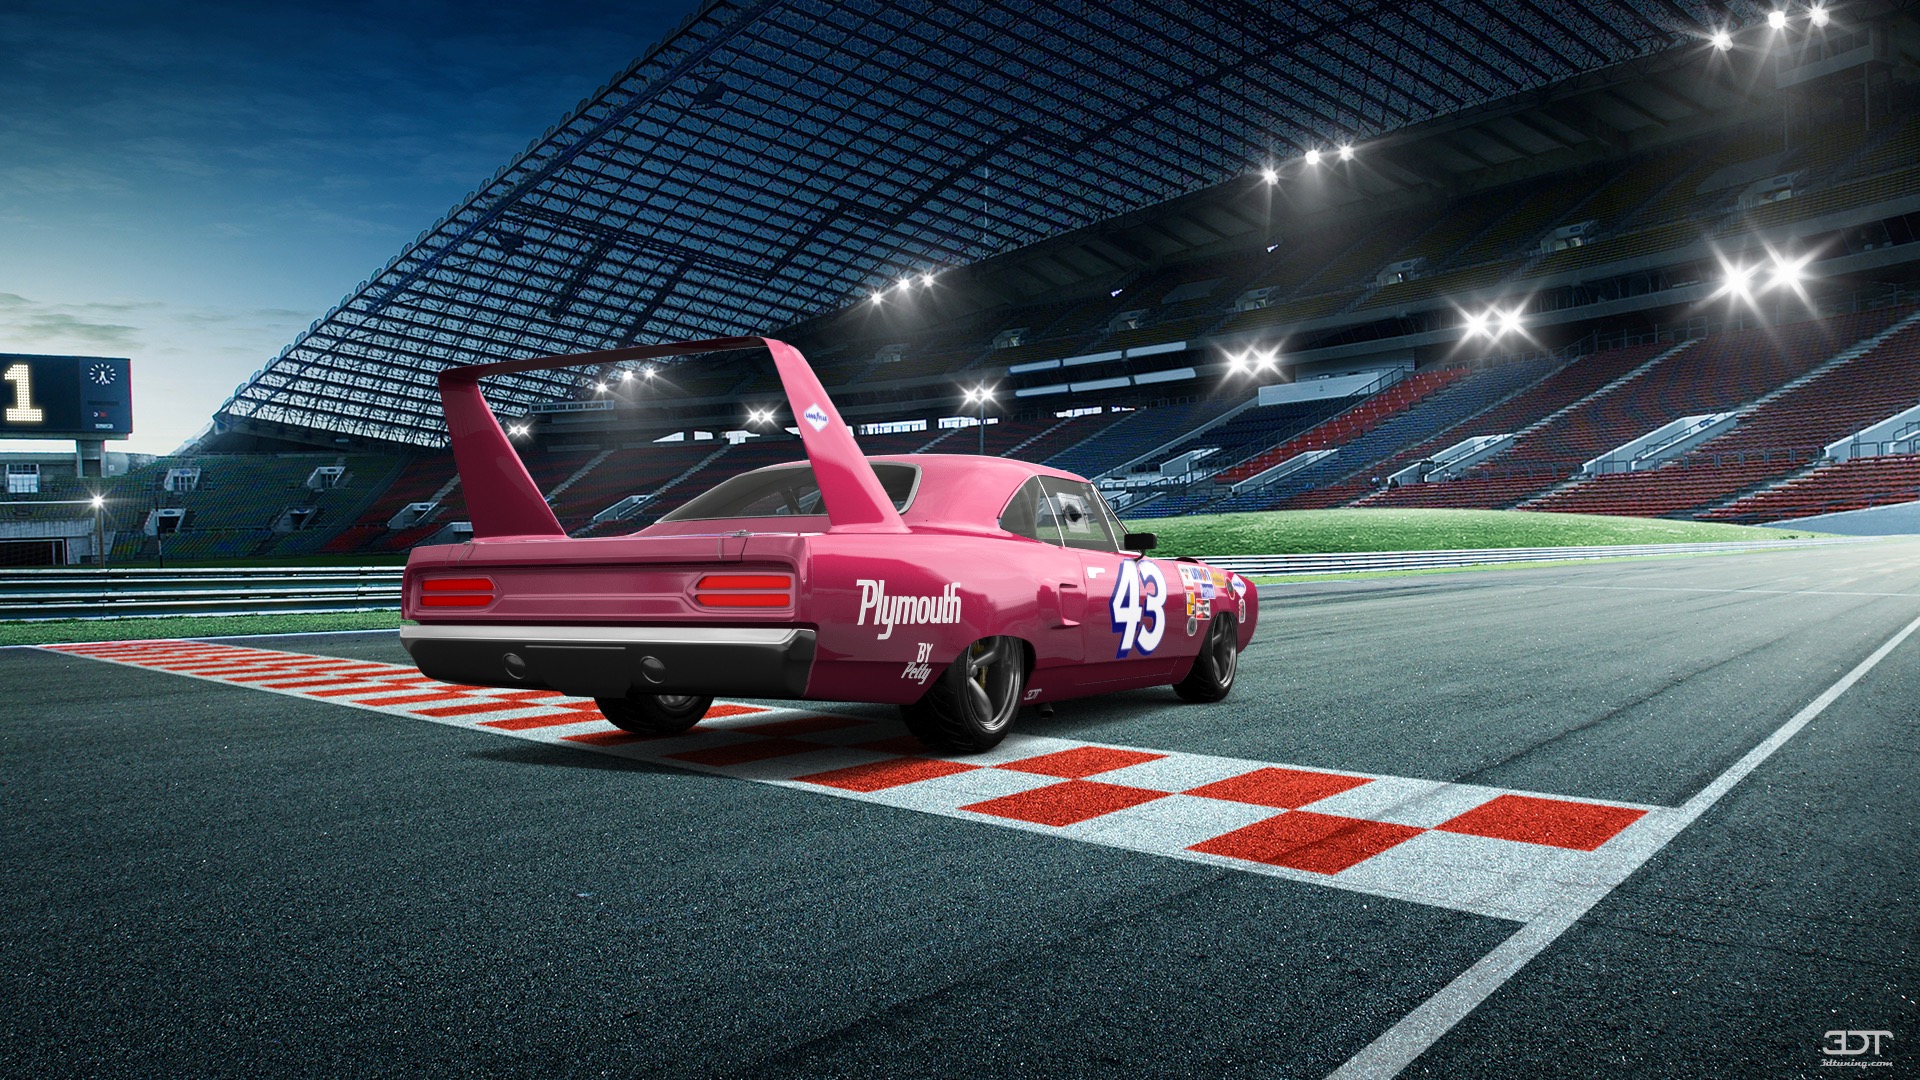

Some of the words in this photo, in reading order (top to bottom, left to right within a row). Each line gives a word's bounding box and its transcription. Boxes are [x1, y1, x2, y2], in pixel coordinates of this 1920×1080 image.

[4, 364, 42, 421] 1
[856, 579, 961, 640] Plymouth
[1109, 559, 1167, 658] 43
[901, 661, 932, 685] Petty
[917, 643, 933, 663] BY
